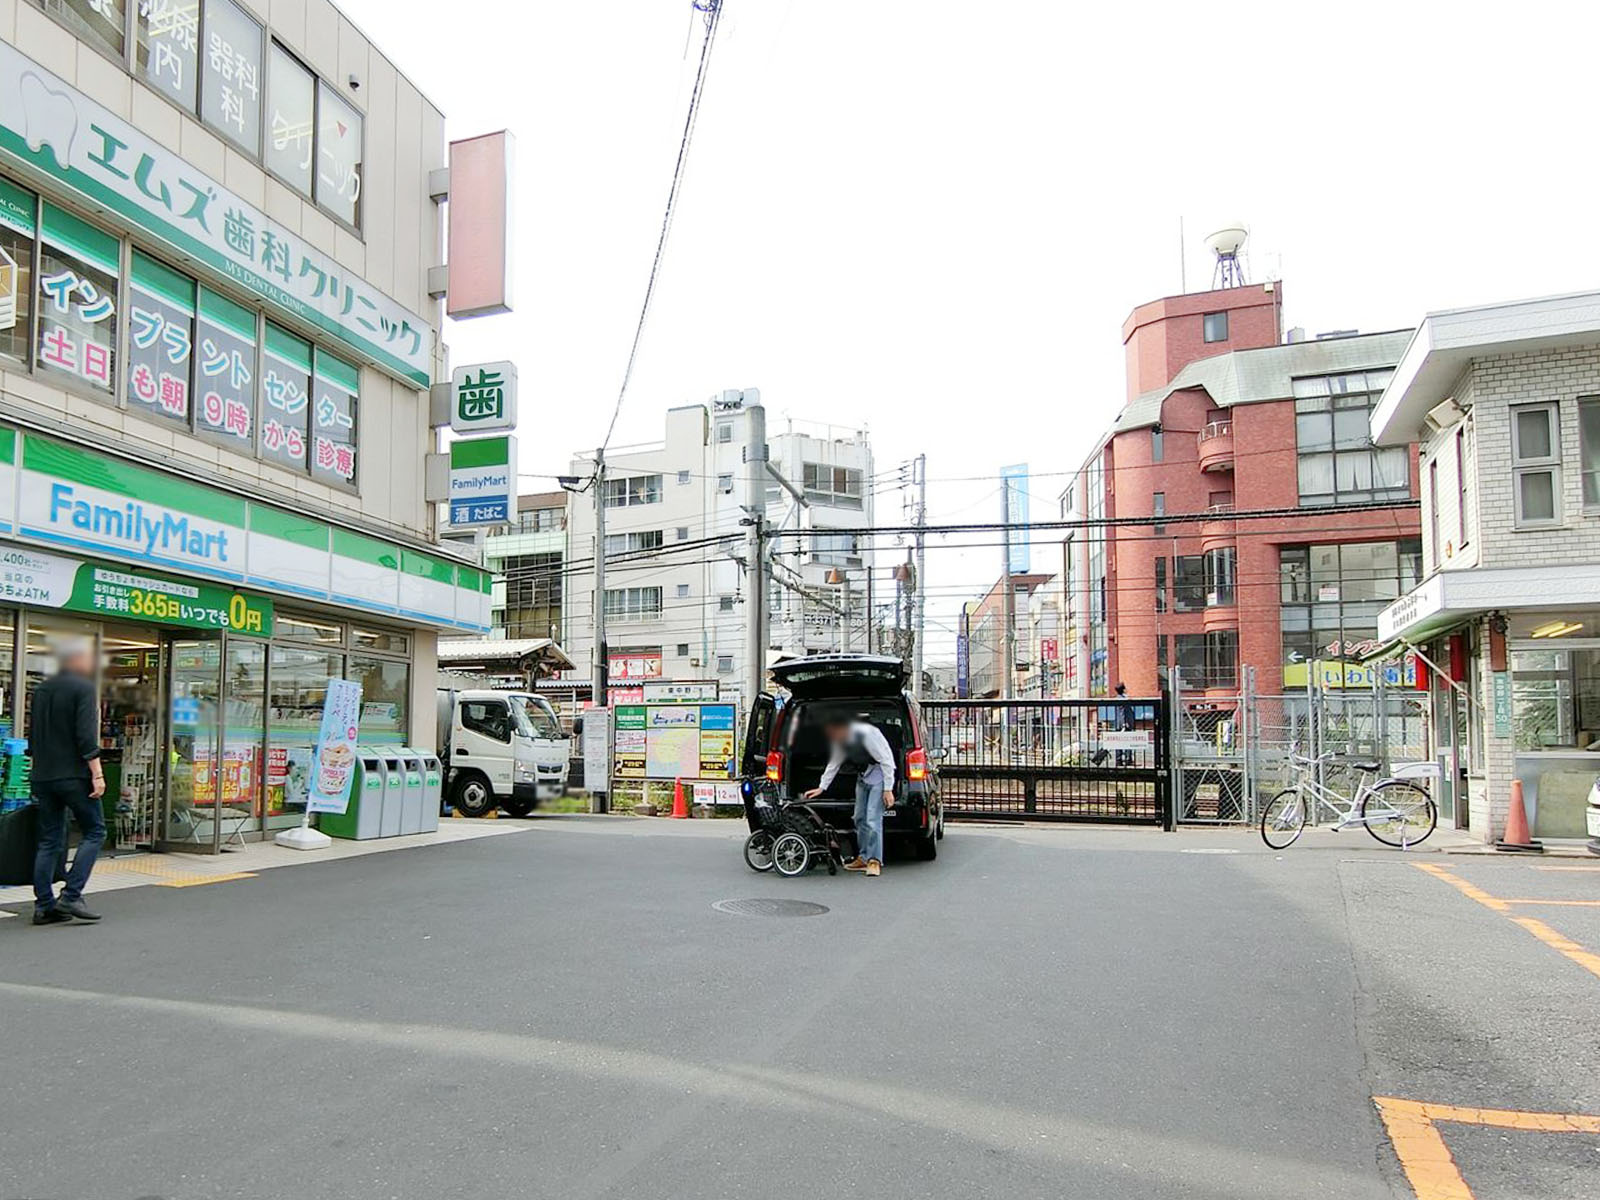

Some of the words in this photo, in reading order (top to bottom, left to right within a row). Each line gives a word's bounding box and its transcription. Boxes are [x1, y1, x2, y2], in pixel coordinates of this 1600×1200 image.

[458, 369, 504, 421] 歯
[452, 474, 507, 490] FamilyMart
[50, 482, 229, 562] FamilyMart
[455, 507, 470, 523] 酒
[474, 506, 503, 521] たばこ
